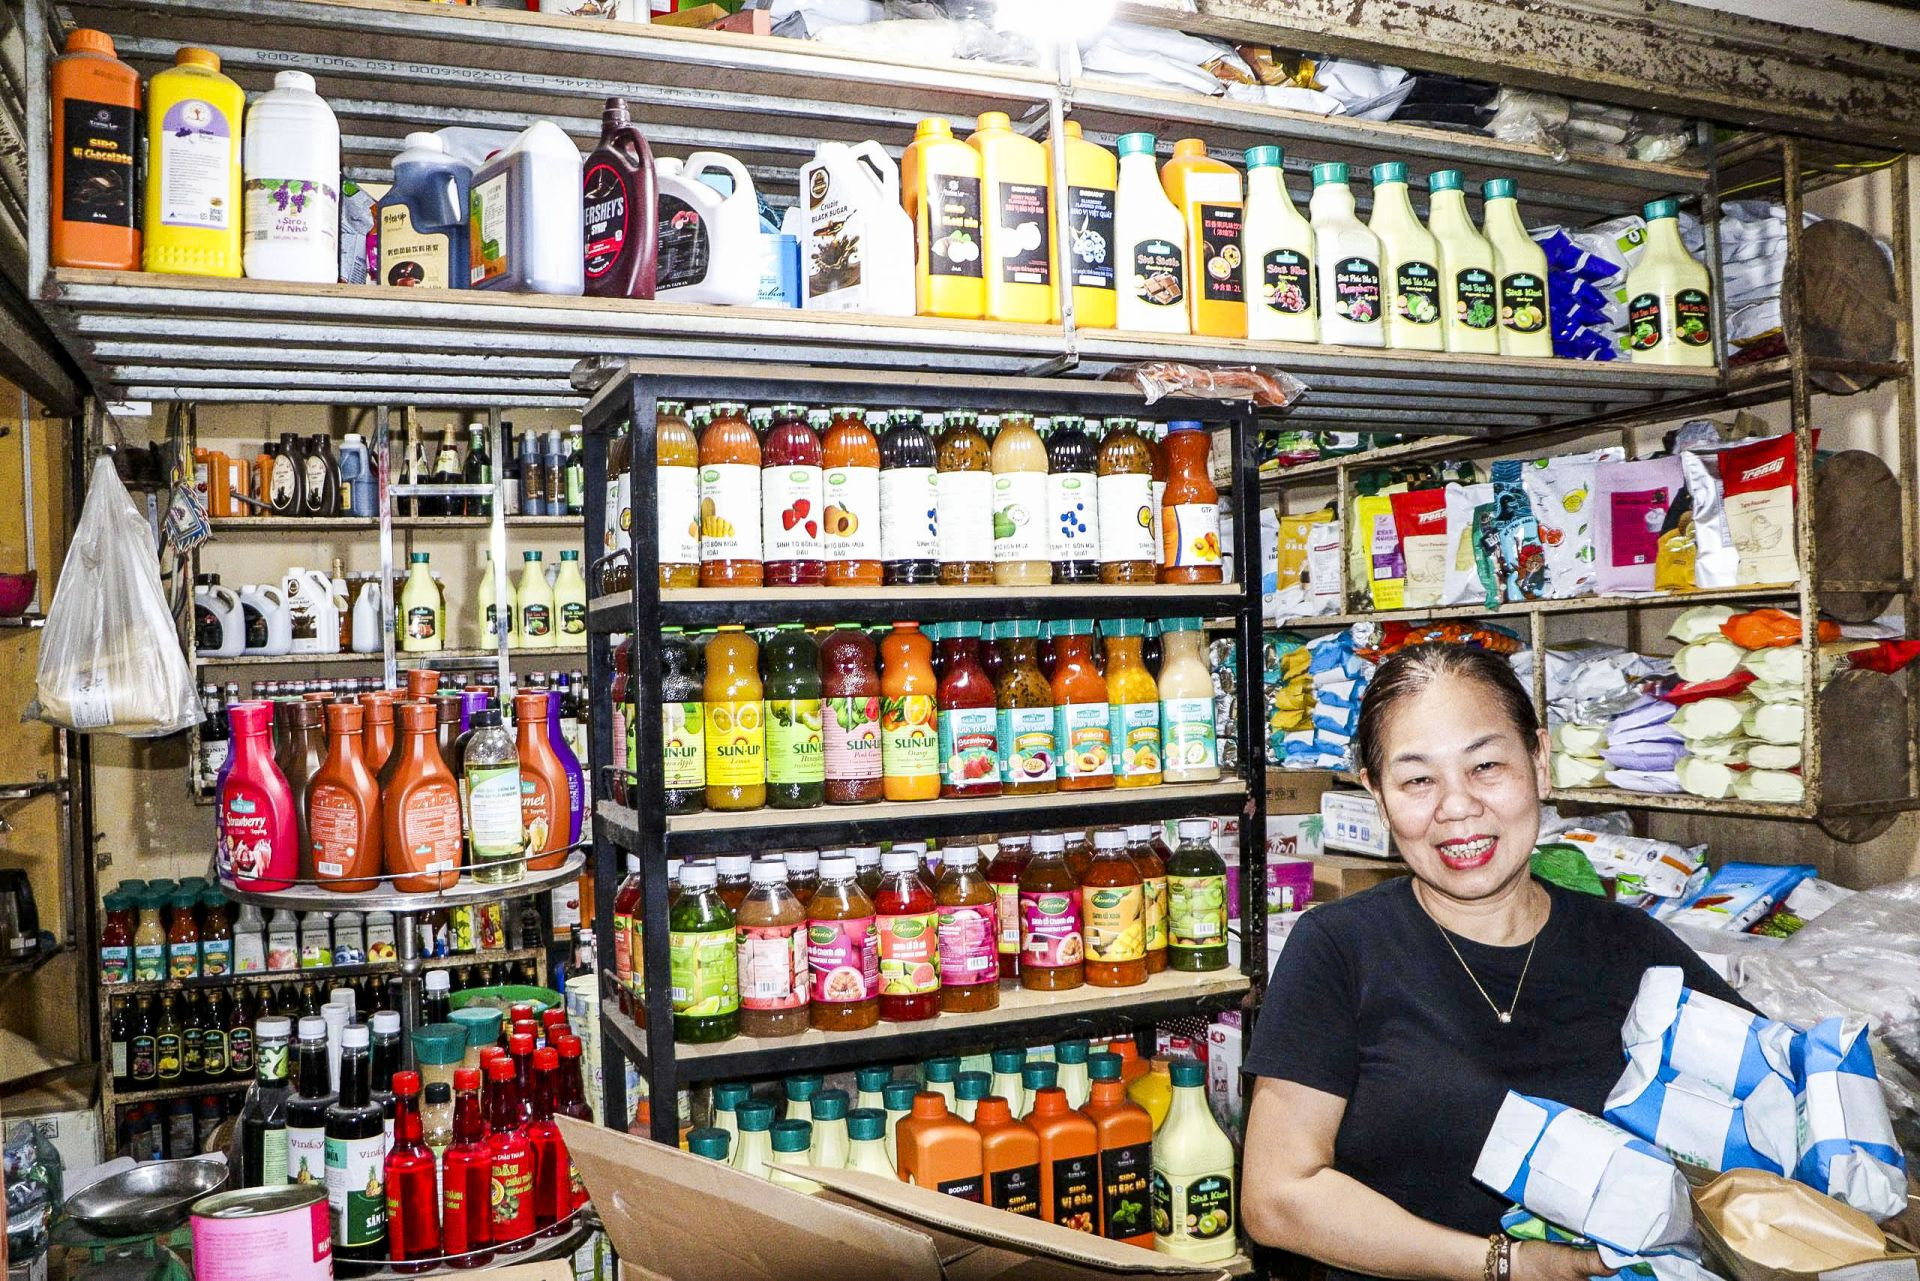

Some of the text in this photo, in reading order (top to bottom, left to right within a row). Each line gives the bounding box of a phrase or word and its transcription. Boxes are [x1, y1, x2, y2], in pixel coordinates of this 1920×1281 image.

[84, 149, 133, 166] Chocolate
[585, 197, 624, 226] ERSHEY'S
[812, 205, 848, 224] BLACK SUGAR
[1338, 284, 1379, 294] Raspberry
[1741, 456, 1786, 482] Trendy
[958, 738, 994, 747] Strawberry
